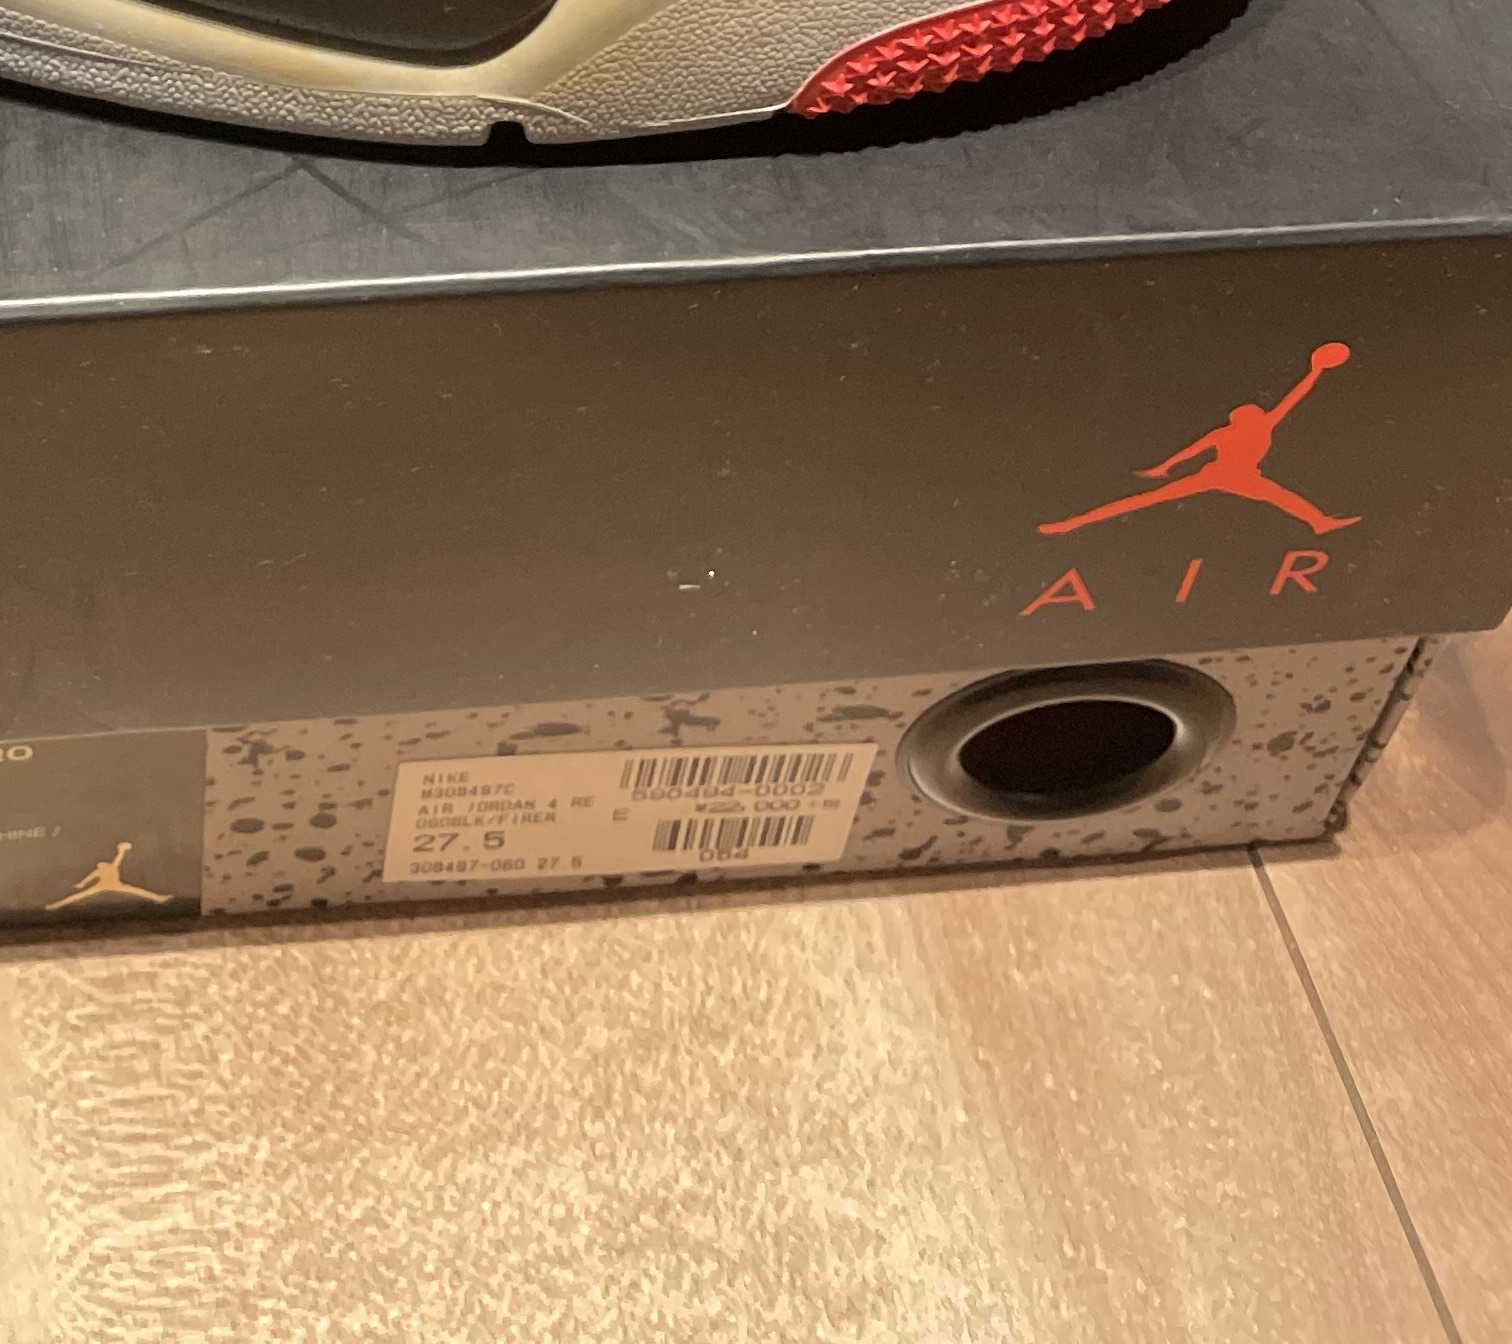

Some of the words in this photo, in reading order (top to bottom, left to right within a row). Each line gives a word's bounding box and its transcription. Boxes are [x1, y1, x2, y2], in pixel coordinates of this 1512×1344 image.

[1019, 548, 1330, 617] AIR
[422, 770, 471, 787] NIKE
[417, 801, 454, 816] AIR
